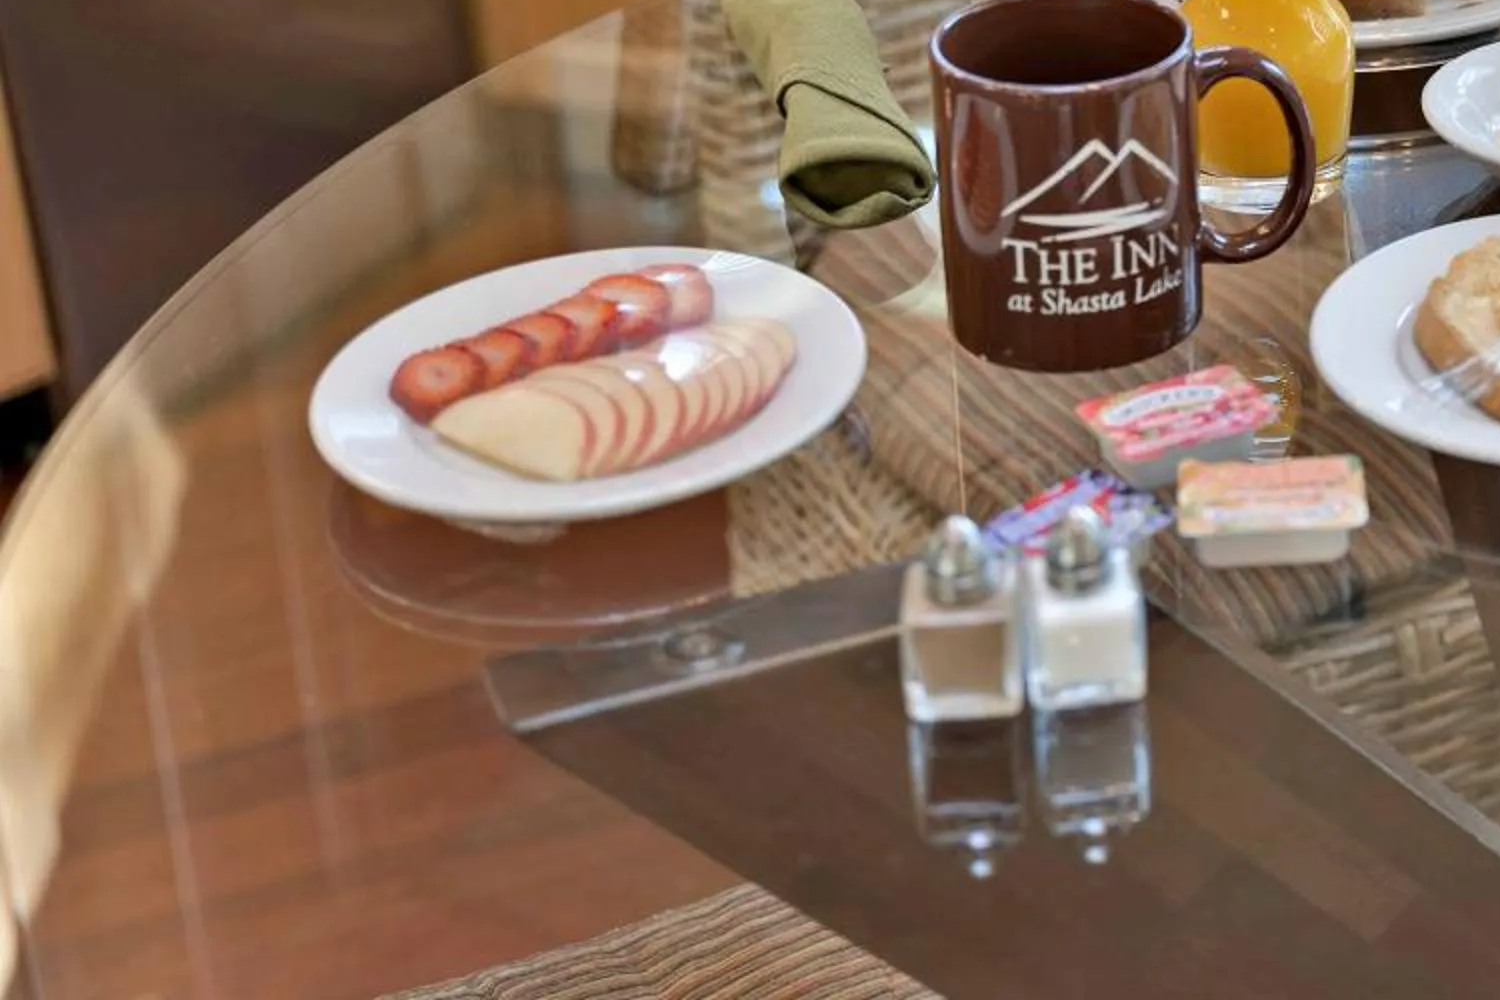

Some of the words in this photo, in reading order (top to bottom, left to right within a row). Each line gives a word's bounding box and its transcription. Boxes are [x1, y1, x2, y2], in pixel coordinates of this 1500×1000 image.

[1002, 237, 1100, 286] THE
[1110, 222, 1179, 279] INN
[1007, 293, 1033, 313] at
[1040, 287, 1127, 316] Shasta
[1134, 266, 1182, 305] Lake
